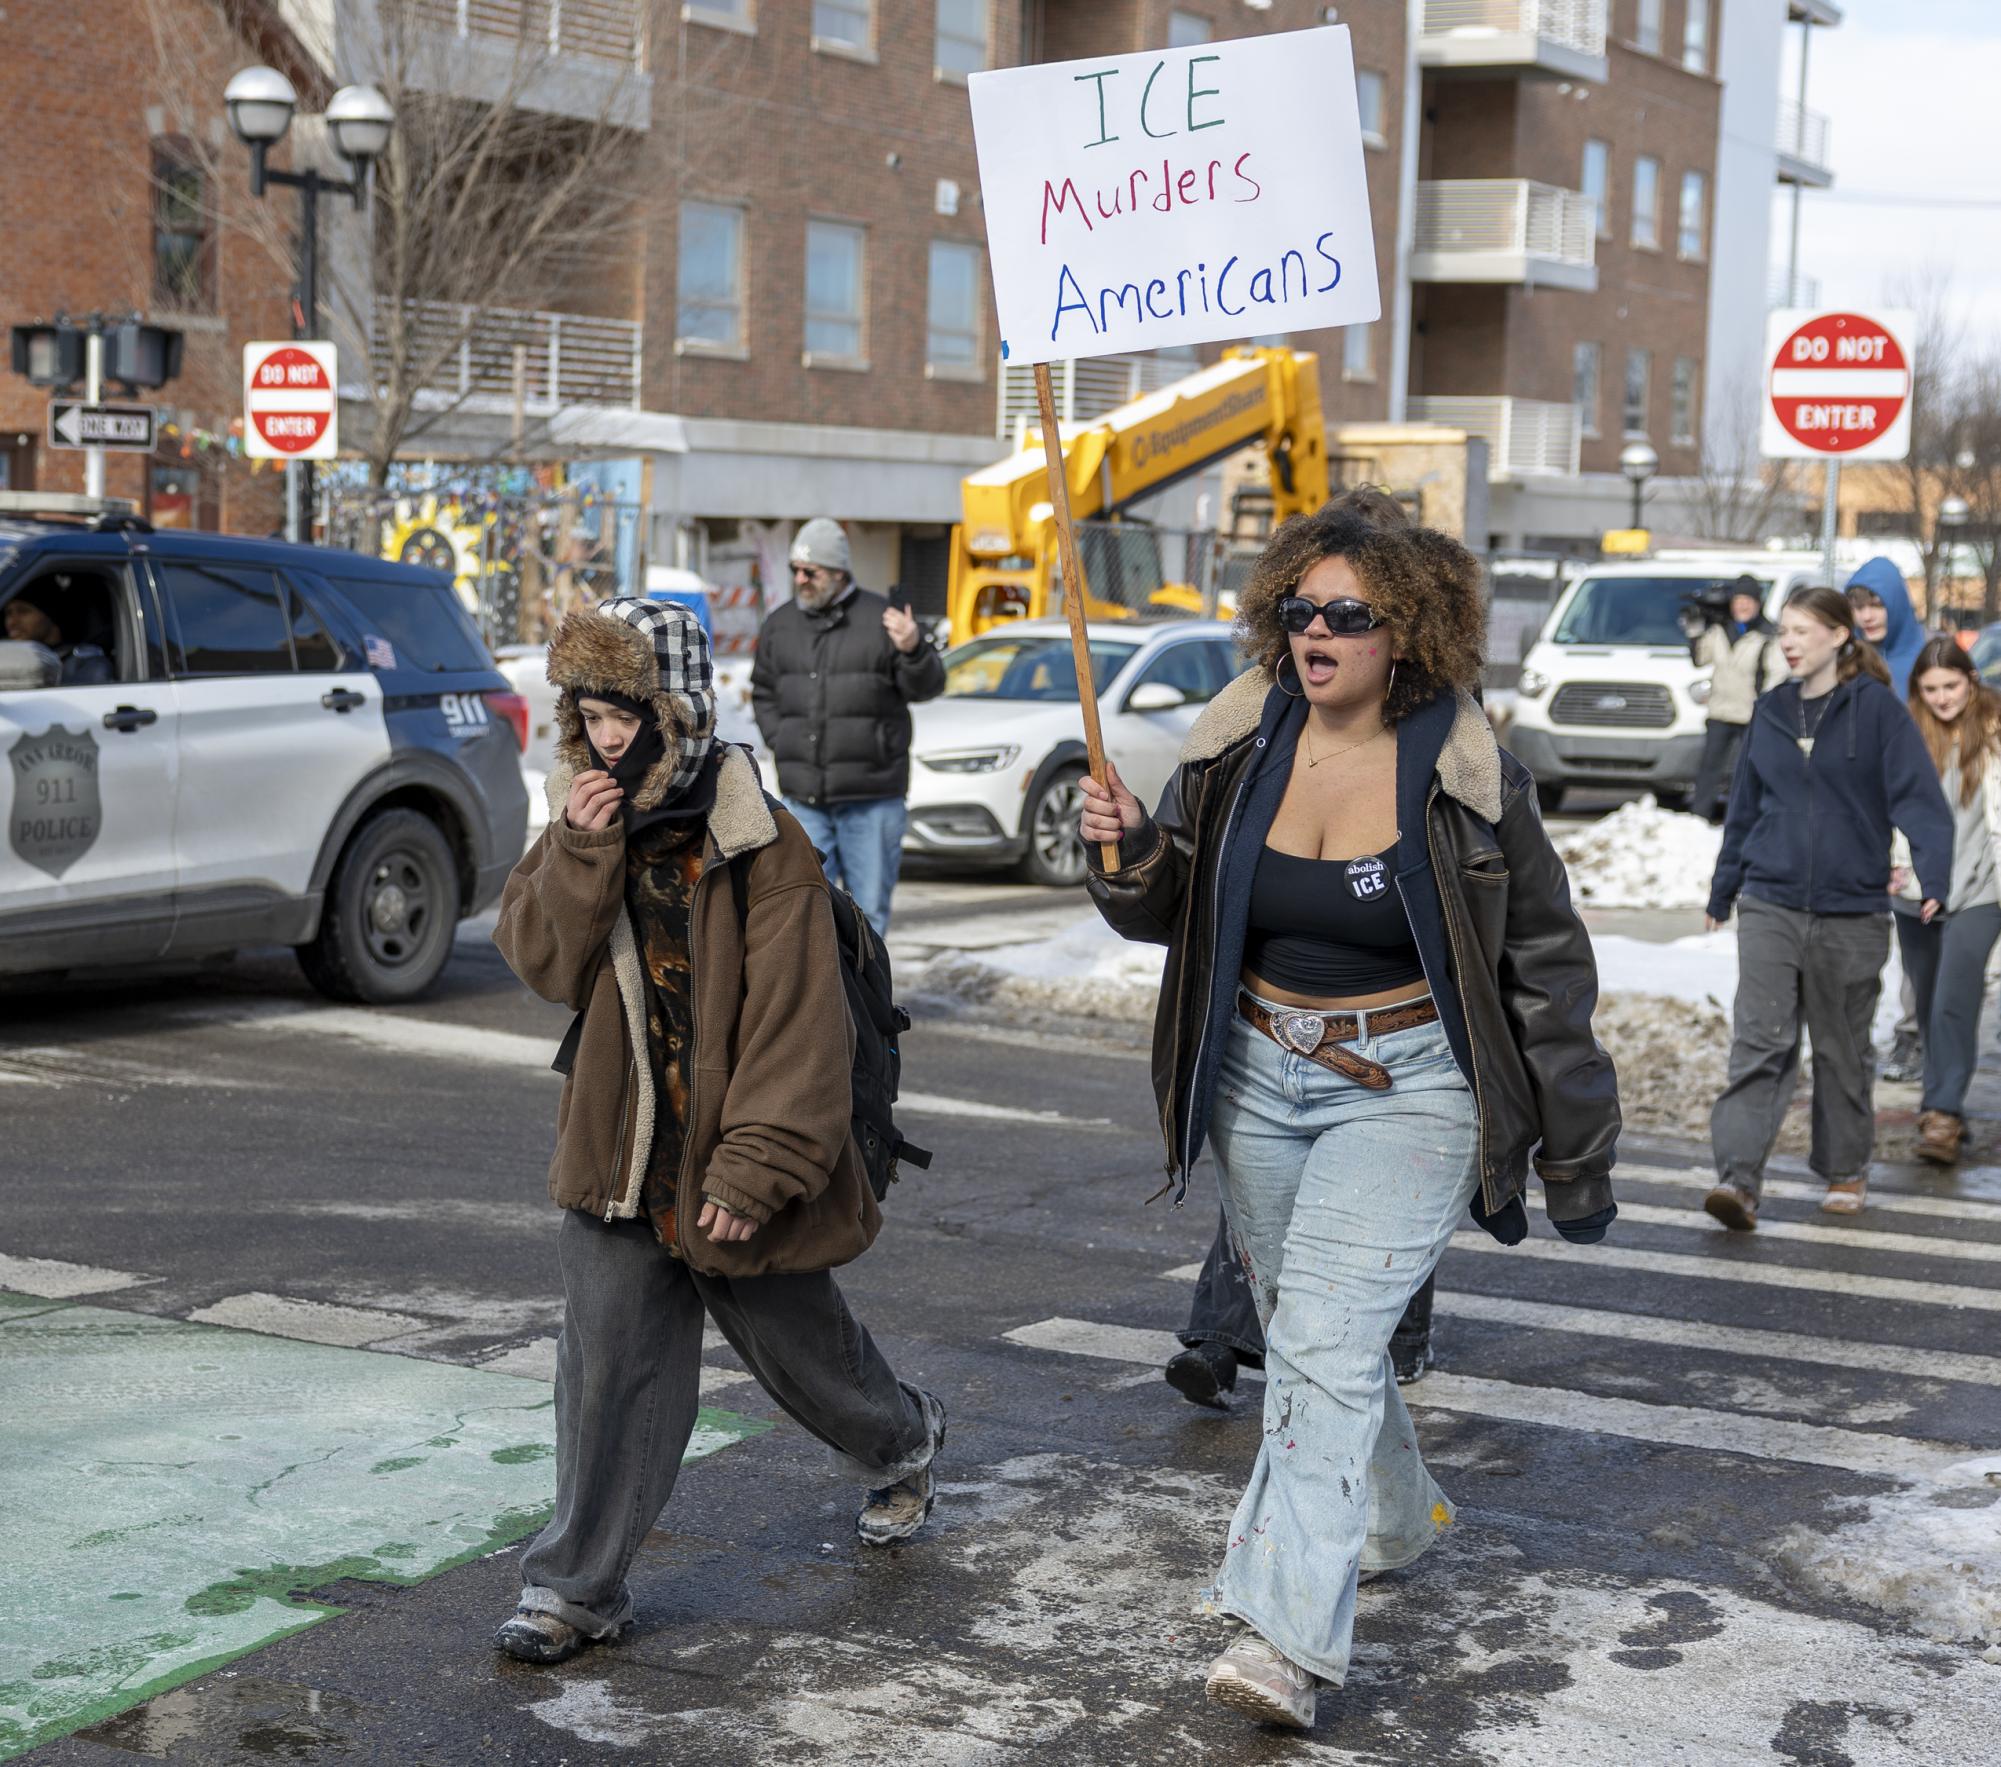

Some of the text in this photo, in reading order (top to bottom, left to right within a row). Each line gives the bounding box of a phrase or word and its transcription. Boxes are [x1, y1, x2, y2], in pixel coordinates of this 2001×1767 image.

[1074, 55, 1225, 149] ICE
[1041, 152, 1261, 245] Murders
[1051, 231, 1342, 342] Americans
[1792, 336, 1888, 362] DO NOT
[260, 364, 319, 384] DO NOT
[81, 414, 149, 440] ONE WAY
[265, 416, 316, 437] ENTER
[1795, 404, 1876, 430] ENTER
[440, 694, 488, 725] 911
[37, 778, 76, 805] 911
[19, 816, 93, 843] POLICE
[1347, 861, 1384, 875] abolish
[1352, 872, 1385, 897] ICE
